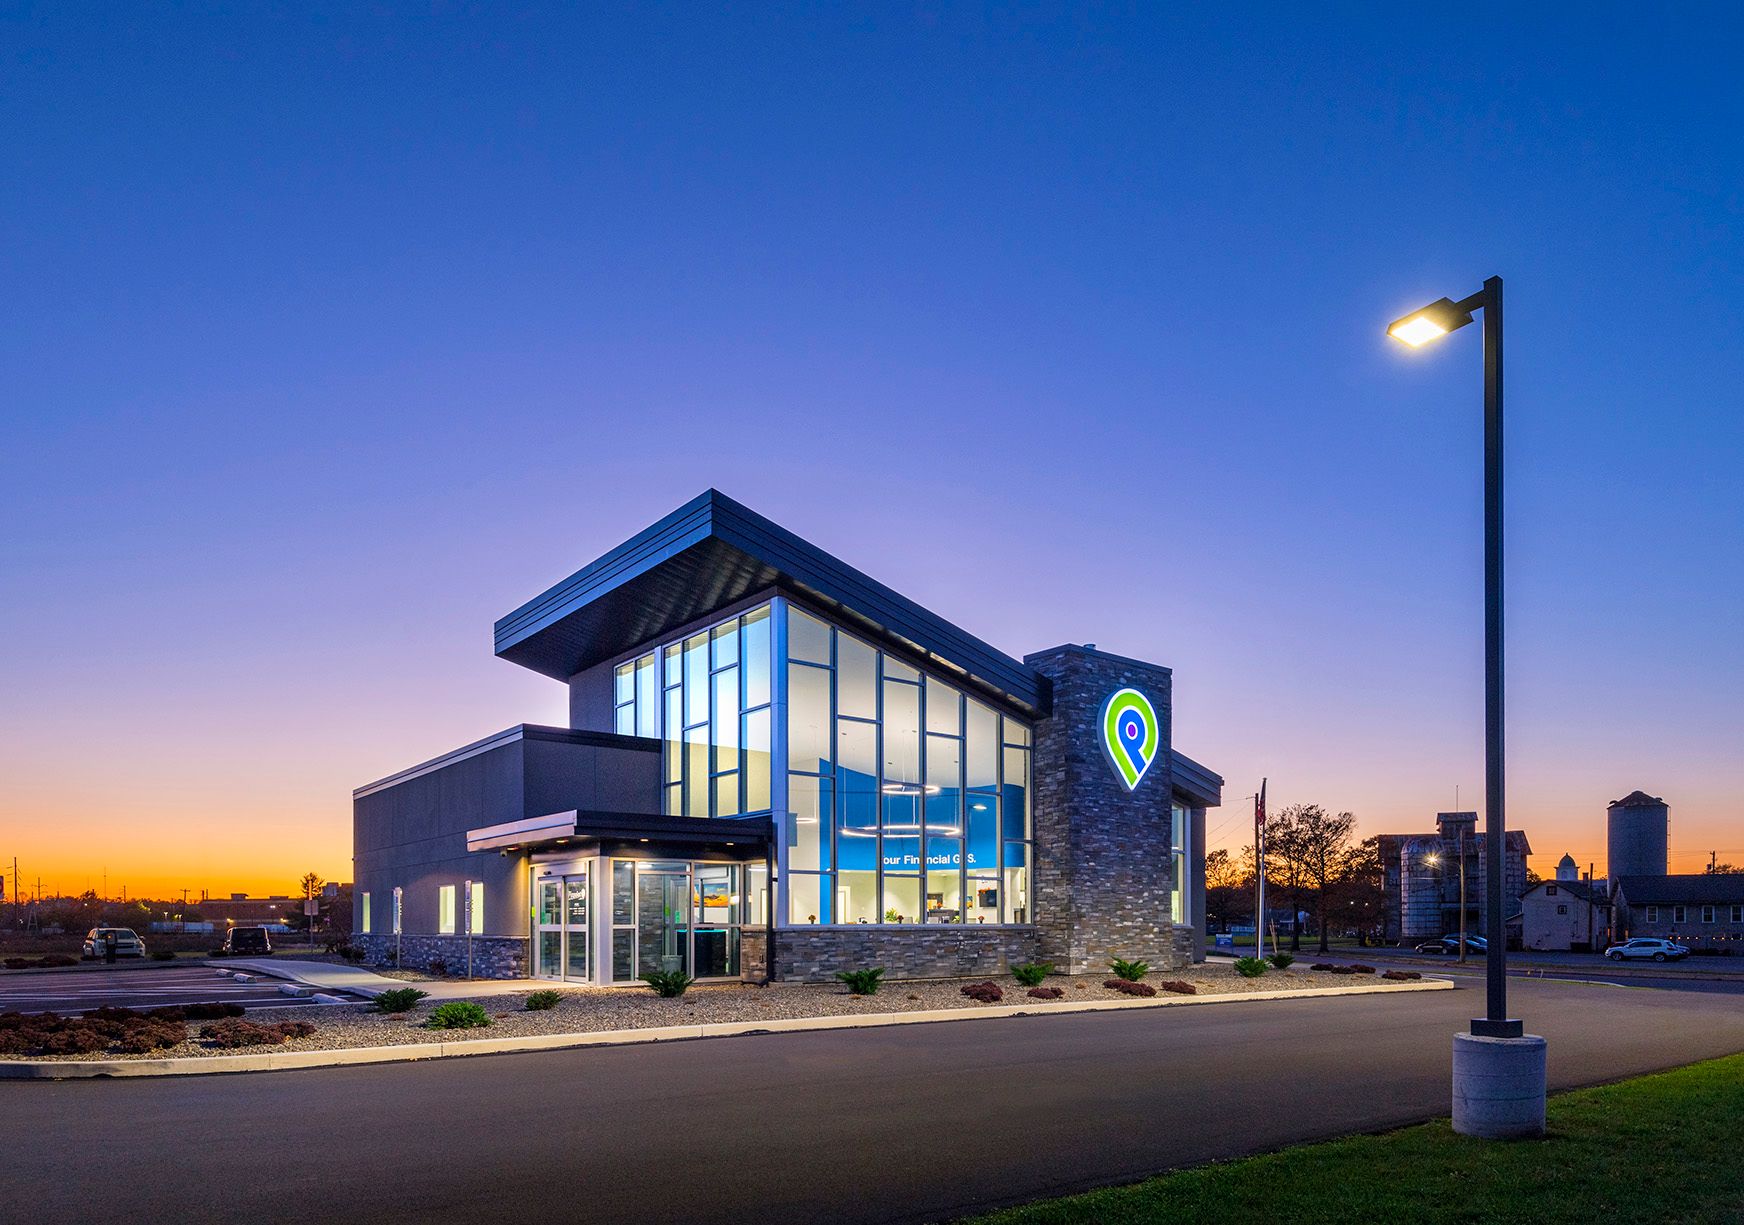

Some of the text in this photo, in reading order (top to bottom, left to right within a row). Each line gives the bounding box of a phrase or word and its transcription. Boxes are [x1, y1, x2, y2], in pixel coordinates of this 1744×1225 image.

[882, 853, 977, 865] our Finncial GS.
